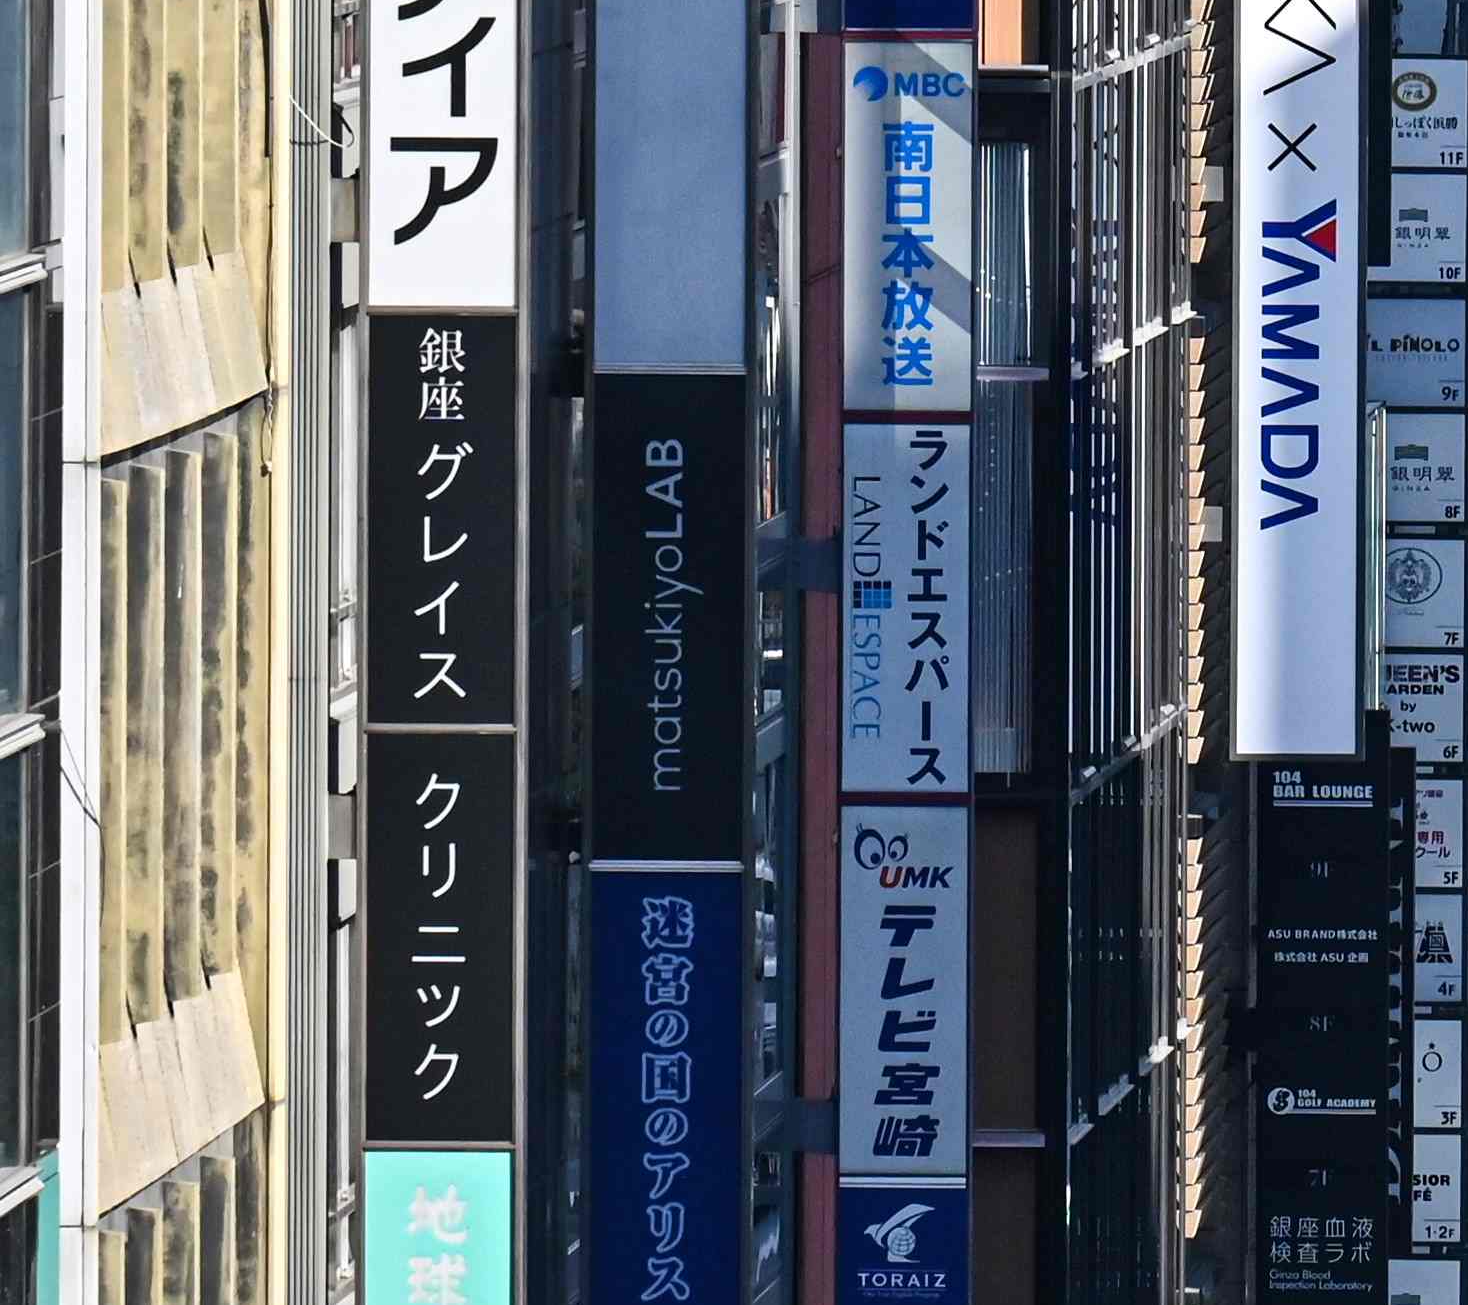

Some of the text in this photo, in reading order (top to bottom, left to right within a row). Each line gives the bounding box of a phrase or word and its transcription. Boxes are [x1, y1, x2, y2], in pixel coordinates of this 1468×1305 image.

[893, 71, 966, 98] MBC
[1439, 151, 1465, 166] 11F
[881, 121, 935, 387] 南日本放送
[1438, 266, 1462, 280] 10F
[1260, 198, 1338, 531] YAMADA
[1441, 386, 1460, 401] 9F
[414, 327, 474, 699] 銀座 グレイス
[1444, 505, 1461, 519] 8F
[645, 437, 704, 791] matsukiyoLAB
[853, 476, 882, 739] LAND ESPACE
[907, 430, 949, 786] ランドエスパース
[1443, 631, 1460, 646] 7F
[1386, 684, 1445, 696] ARDEN
[1400, 702, 1417, 714] by
[1442, 745, 1460, 759] 6F
[1272, 770, 1302, 784] 104
[1272, 785, 1374, 800] BAR LOUNGE
[879, 867, 952, 889] UMK
[1442, 870, 1459, 885] 5F
[411, 772, 467, 1100] クリニック
[1268, 929, 1291, 940] ASU
[1321, 952, 1345, 964] ASU
[1437, 982, 1455, 997] 4F
[874, 905, 940, 1158] テレビ宮崎
[640, 896, 694, 1301] 迷宮の国のアリス
[1440, 1110, 1458, 1126] 3F
[1269, 1215, 1375, 1240] 銀座血液
[1269, 1242, 1373, 1264] 検査ラボ
[858, 1272, 947, 1289] TORAIZ
[1269, 1269, 1332, 1281] Ginza Blood
[1269, 1281, 1374, 1293] Inspection Laboratory
